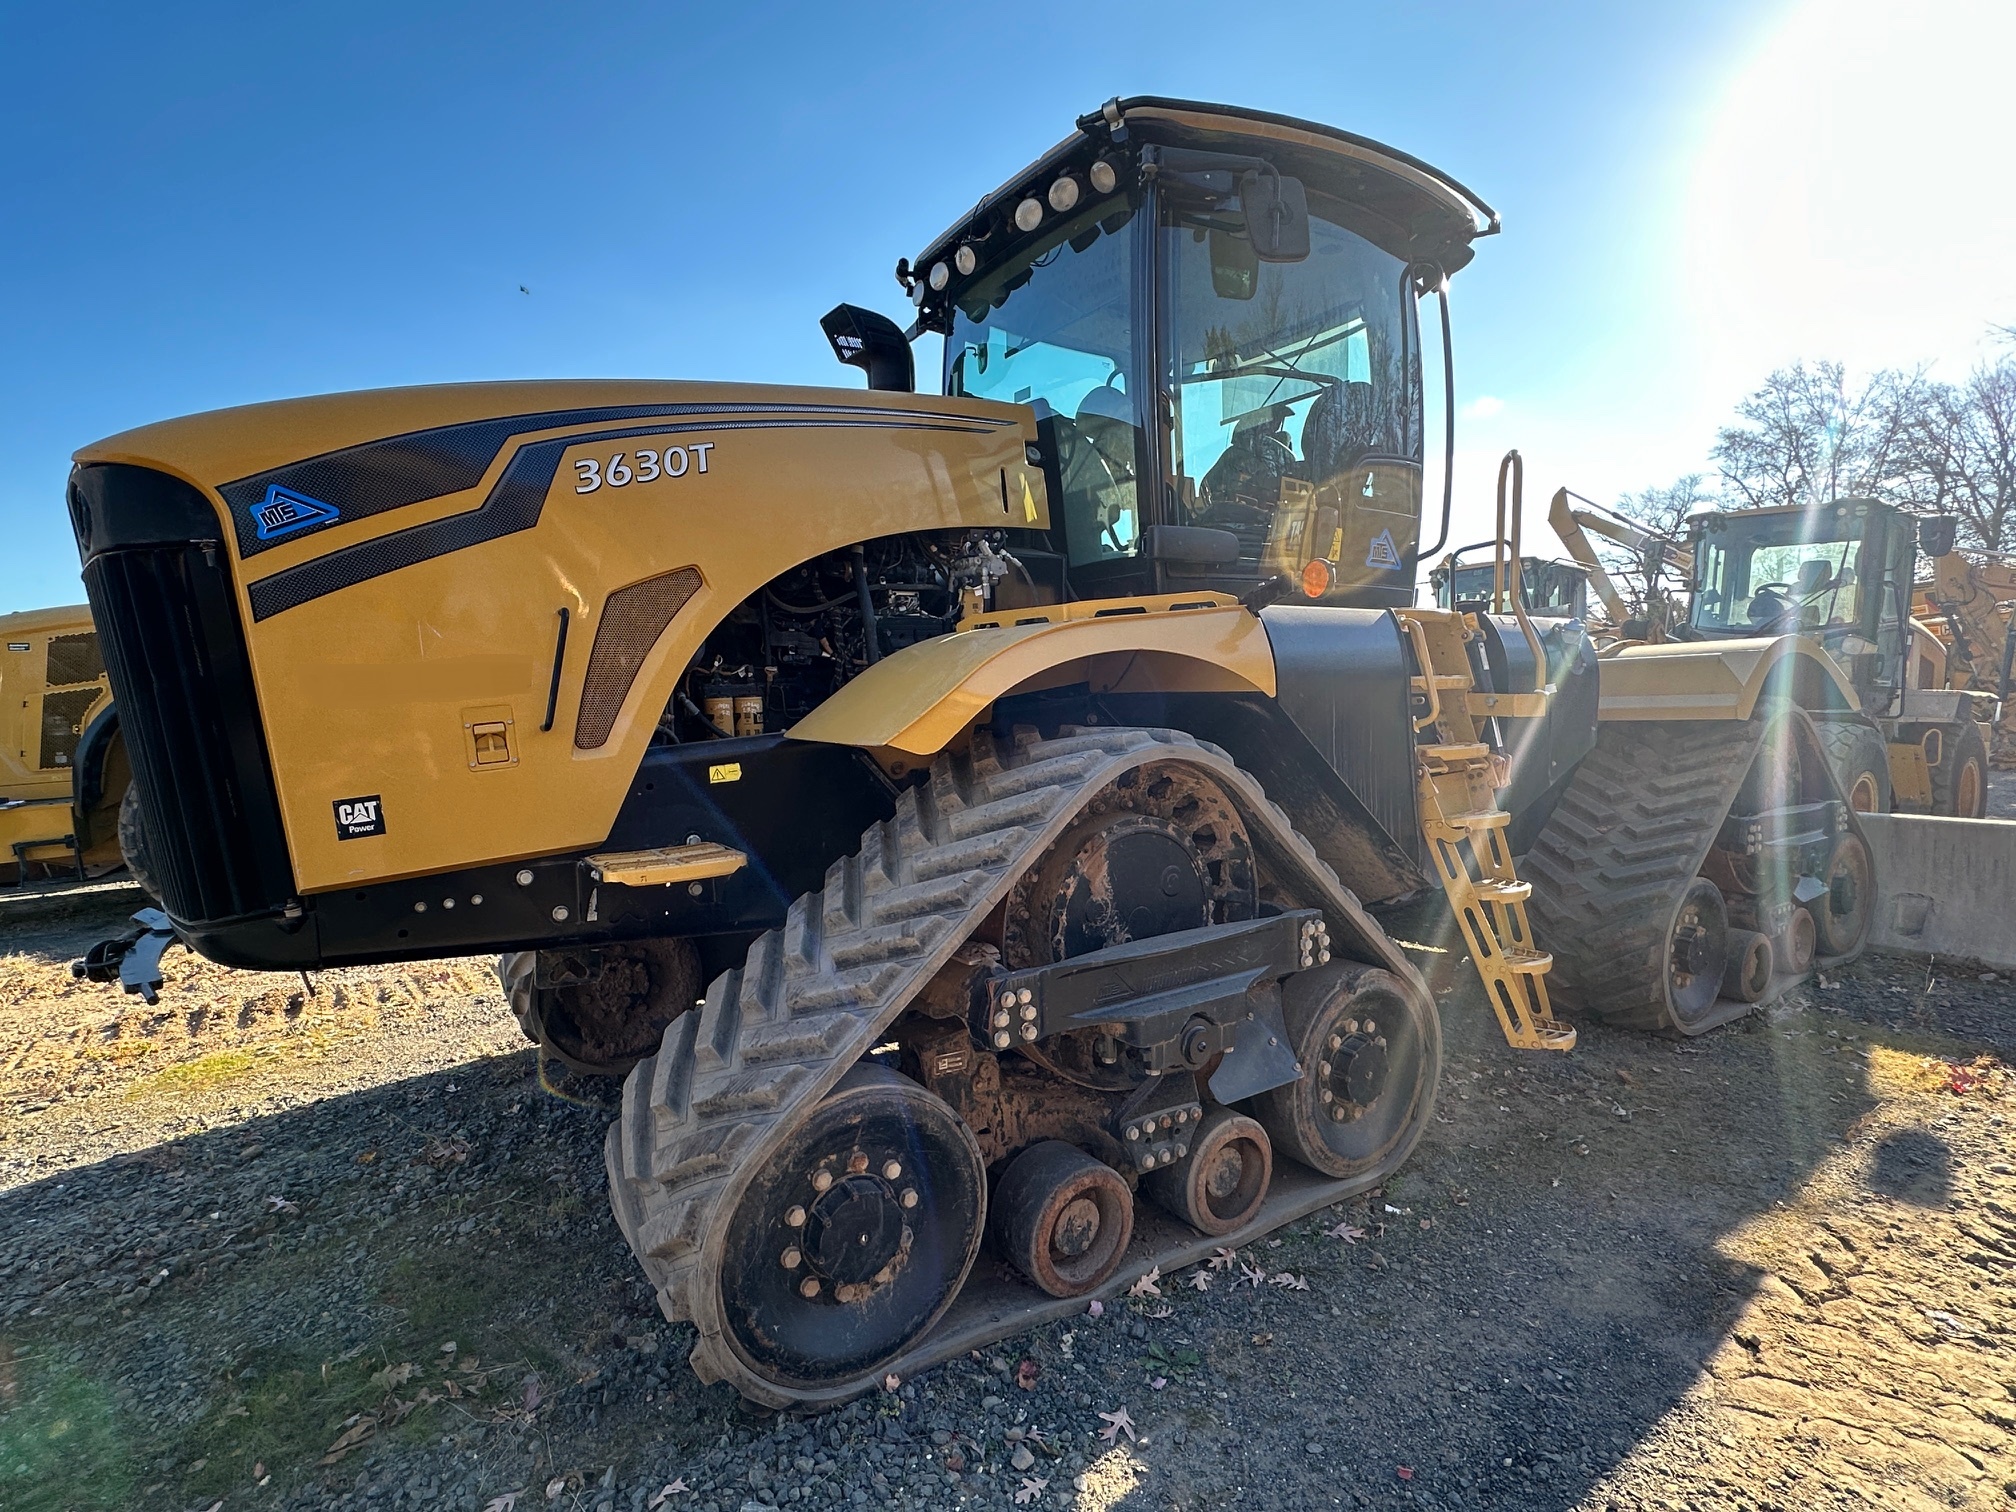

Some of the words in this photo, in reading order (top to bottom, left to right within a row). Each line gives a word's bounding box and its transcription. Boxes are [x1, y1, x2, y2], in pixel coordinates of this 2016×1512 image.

[574, 442, 714, 494] 3630T
[338, 801, 377, 825] CAT
[349, 825, 375, 833] Power
